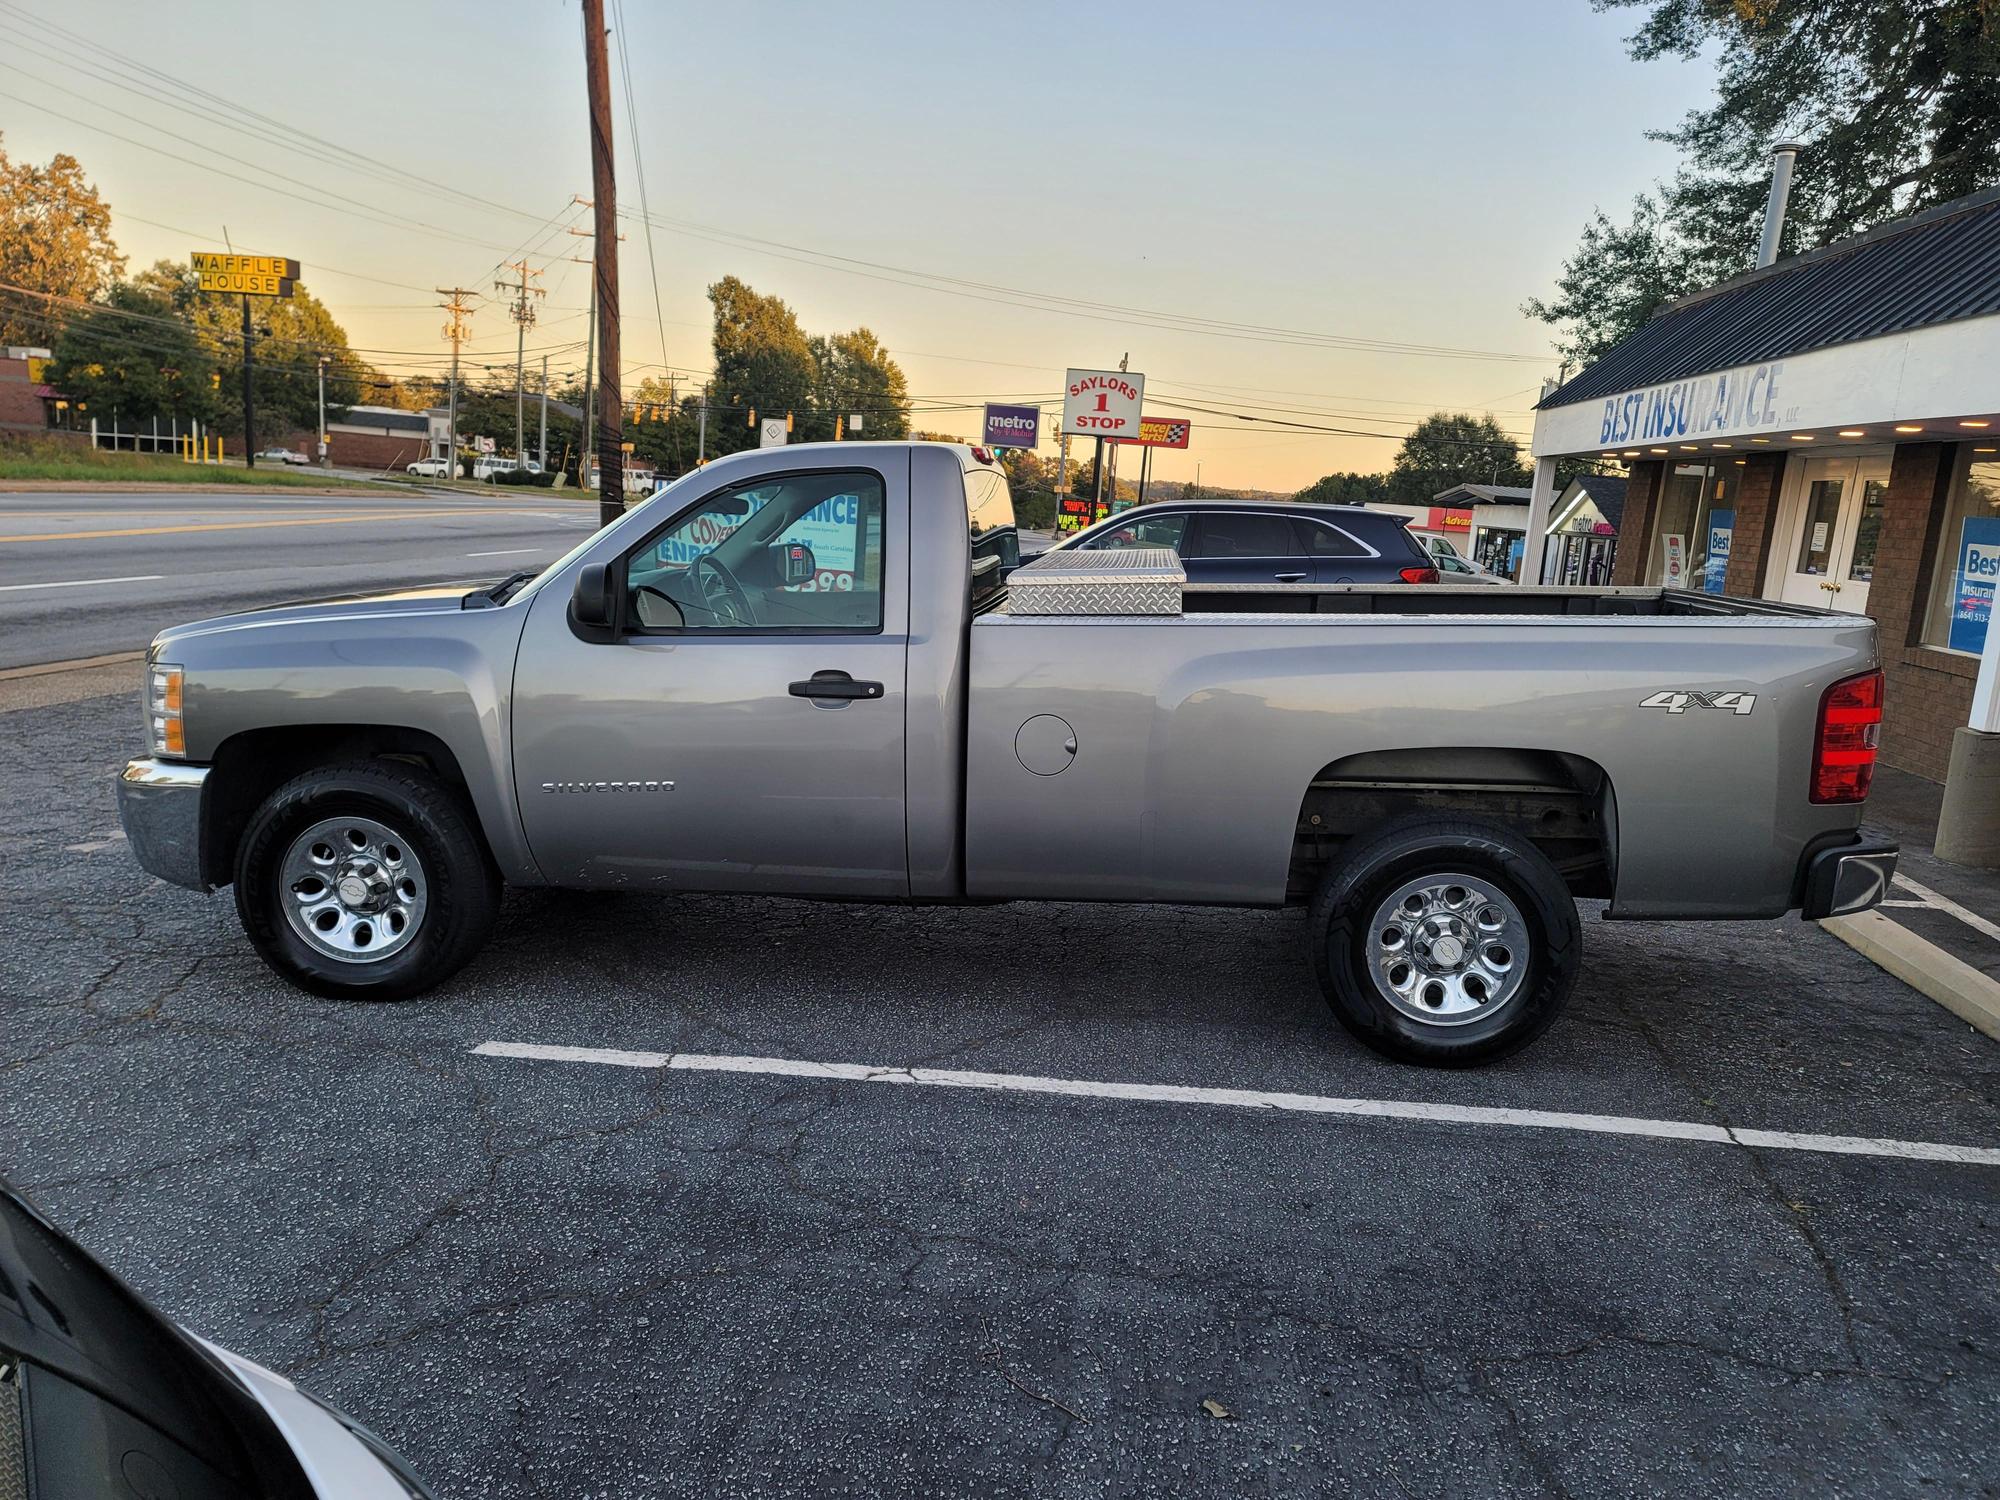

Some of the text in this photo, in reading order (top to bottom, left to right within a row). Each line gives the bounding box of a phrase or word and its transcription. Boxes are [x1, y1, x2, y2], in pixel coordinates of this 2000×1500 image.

[192, 255, 283, 274] WAFFLE
[202, 274, 275, 292] HOUSE
[1069, 376, 1137, 400] SAYLORS
[1092, 393, 1110, 412] 1
[989, 415, 1035, 431] metro
[1075, 415, 1126, 429] STOP
[1138, 422, 1163, 432] ance
[1600, 392, 1645, 444] BEST
[799, 496, 857, 525] ANCE
[1058, 514, 1078, 525] VAPE
[1572, 514, 1593, 533] metro
[1712, 532, 1730, 550] Best
[541, 781, 676, 794] SILVERADO
